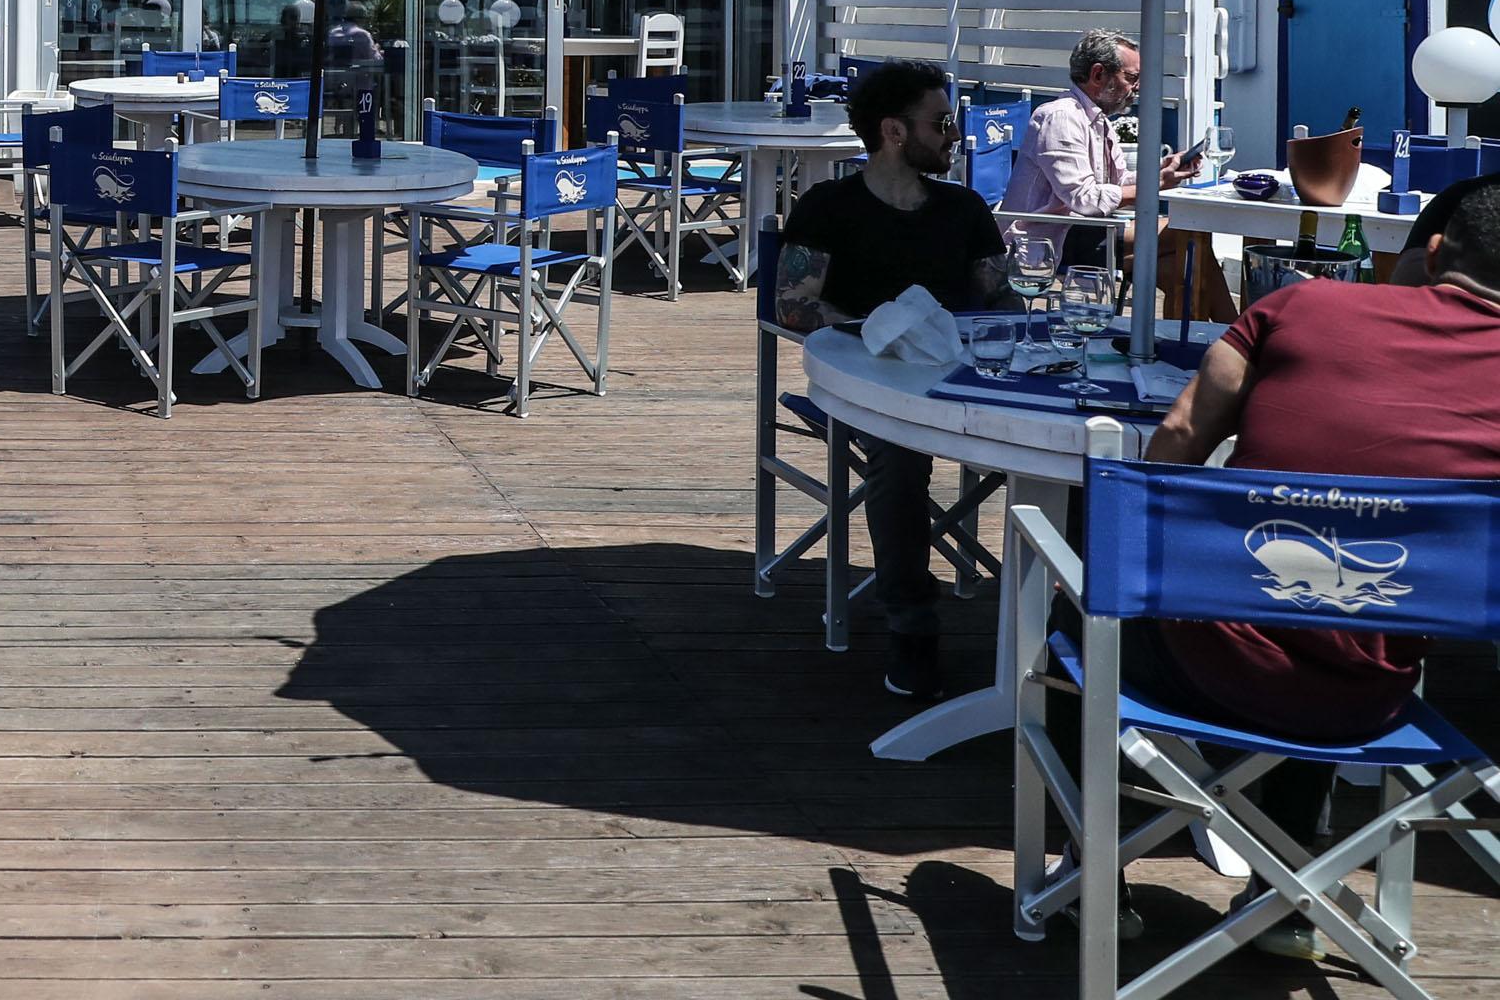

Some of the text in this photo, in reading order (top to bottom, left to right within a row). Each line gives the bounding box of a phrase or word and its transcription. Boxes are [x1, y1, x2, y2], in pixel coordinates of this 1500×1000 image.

[793, 64, 806, 80] 22
[359, 92, 373, 114] 19
[1394, 133, 1411, 158] 21
[1247, 484, 1410, 519] la Scialuppa
